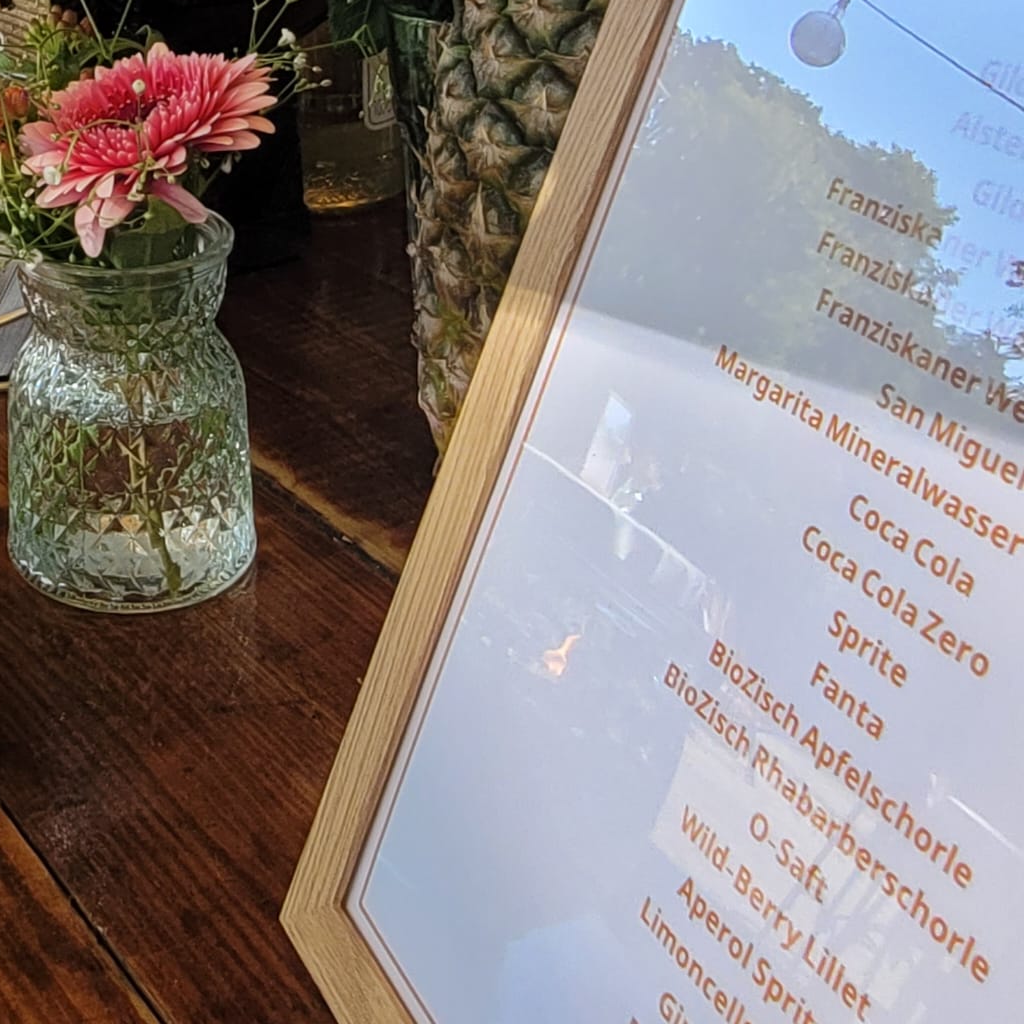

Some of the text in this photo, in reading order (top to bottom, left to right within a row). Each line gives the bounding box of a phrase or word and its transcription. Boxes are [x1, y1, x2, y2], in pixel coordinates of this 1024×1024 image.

[950, 110, 1024, 160] Alste
[815, 288, 982, 394] Franziskaner
[714, 344, 1024, 556] Margarita Mineralwasser
[875, 383, 925, 430] San
[848, 494, 976, 598] Coca Cola
[801, 525, 991, 678] Coca Cola Zero
[827, 609, 908, 688] Sprite
[809, 661, 885, 741] Fanta
[708, 638, 973, 890] BioZisch Apfelschorle
[662, 662, 991, 984] BioZisch Rhabarberschorle
[749, 812, 829, 904] O-Saft
[639, 895, 753, 1024] Limoncell
[676, 876, 755, 970] Aperol
[680, 803, 873, 1023] Wild-Berry Lillet
